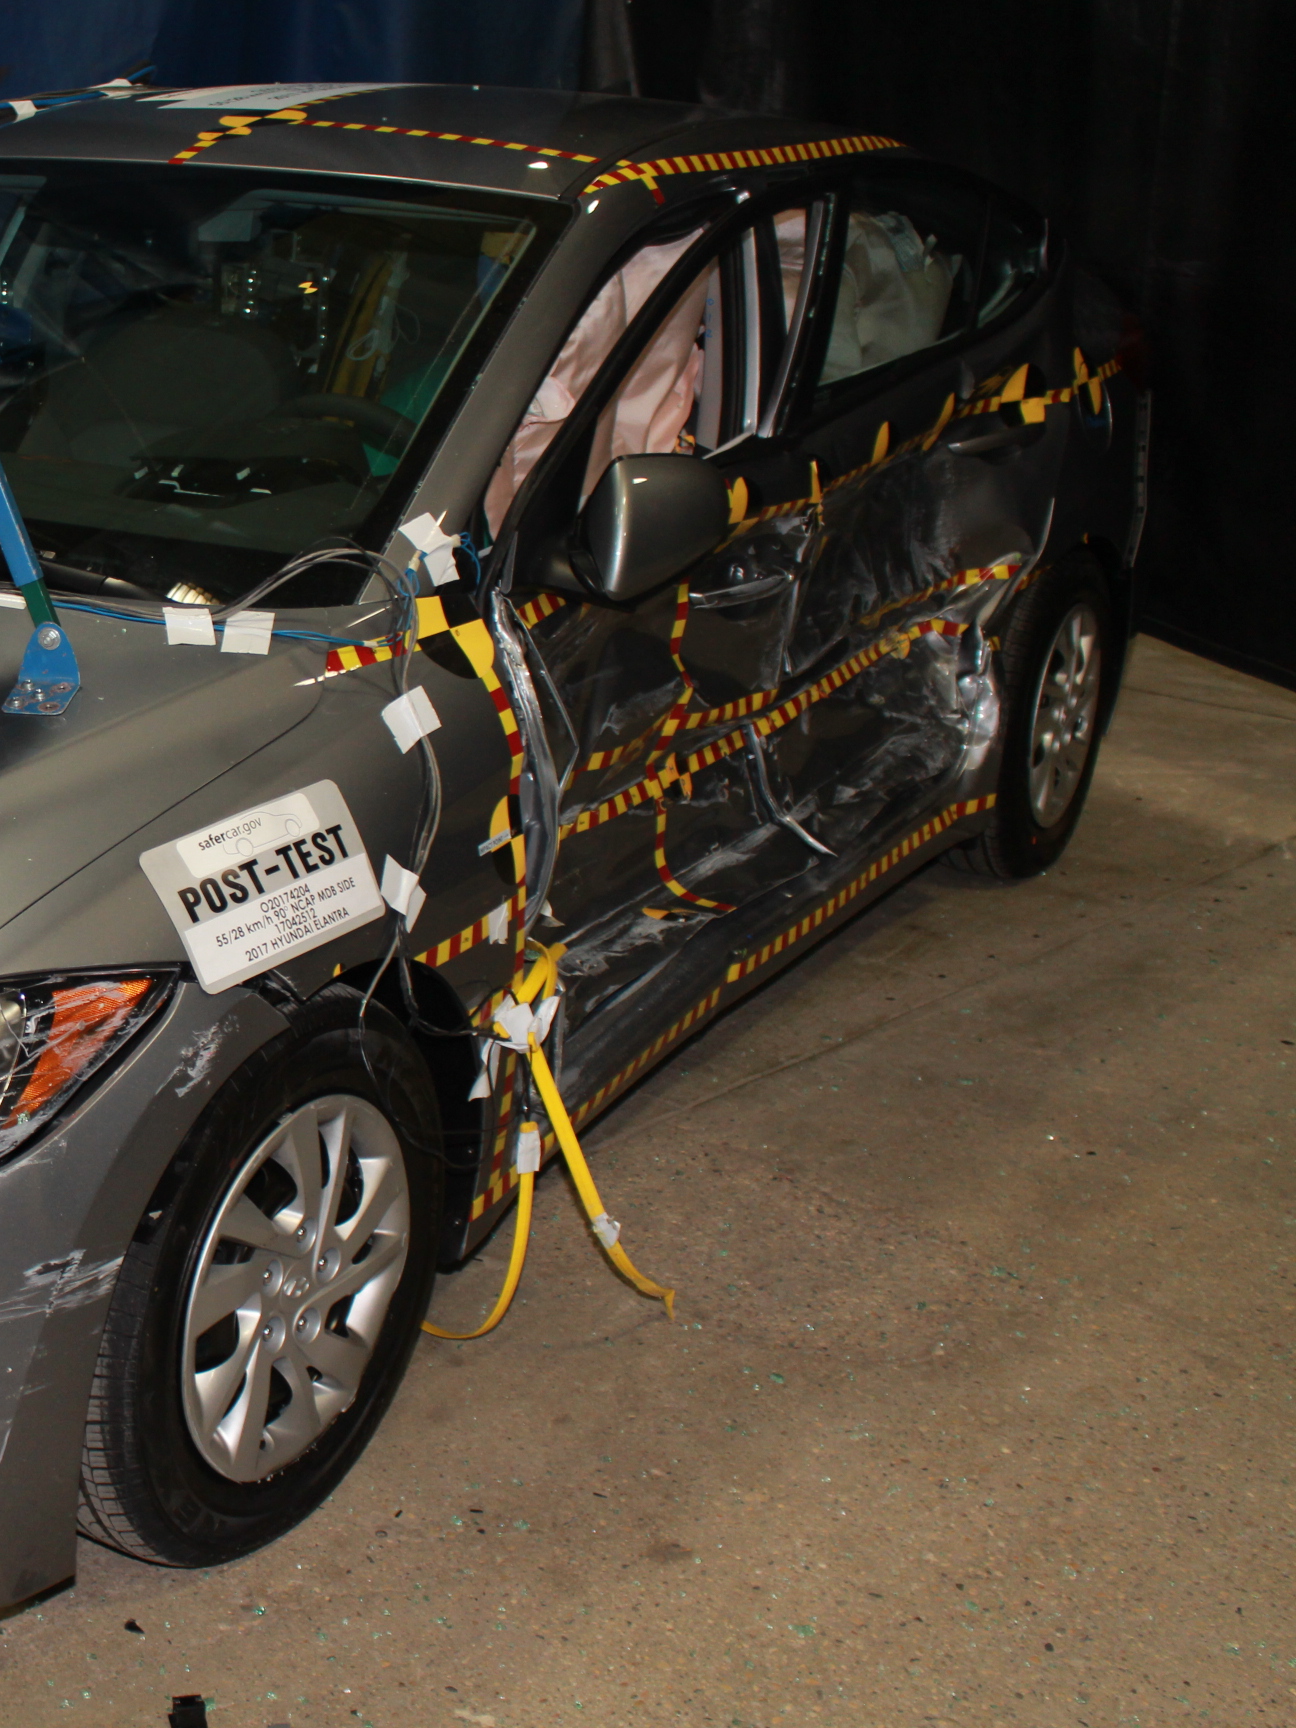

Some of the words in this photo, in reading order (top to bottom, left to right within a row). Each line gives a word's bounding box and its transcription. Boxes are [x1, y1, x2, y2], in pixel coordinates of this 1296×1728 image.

[198, 817, 262, 851] safercar.gov
[177, 824, 349, 923] POST-TEST
[216, 926, 245, 947] 55/28
[245, 914, 274, 934] km/h
[273, 906, 288, 920] 90°
[291, 894, 316, 913] NCAP
[317, 886, 337, 902] MDB
[336, 877, 356, 893] SIDE
[245, 943, 269, 962] 2017
[270, 926, 315, 950] HYUNDAI
[315, 907, 350, 930] ELANTRA
[275, 908, 317, 934] 17042512
